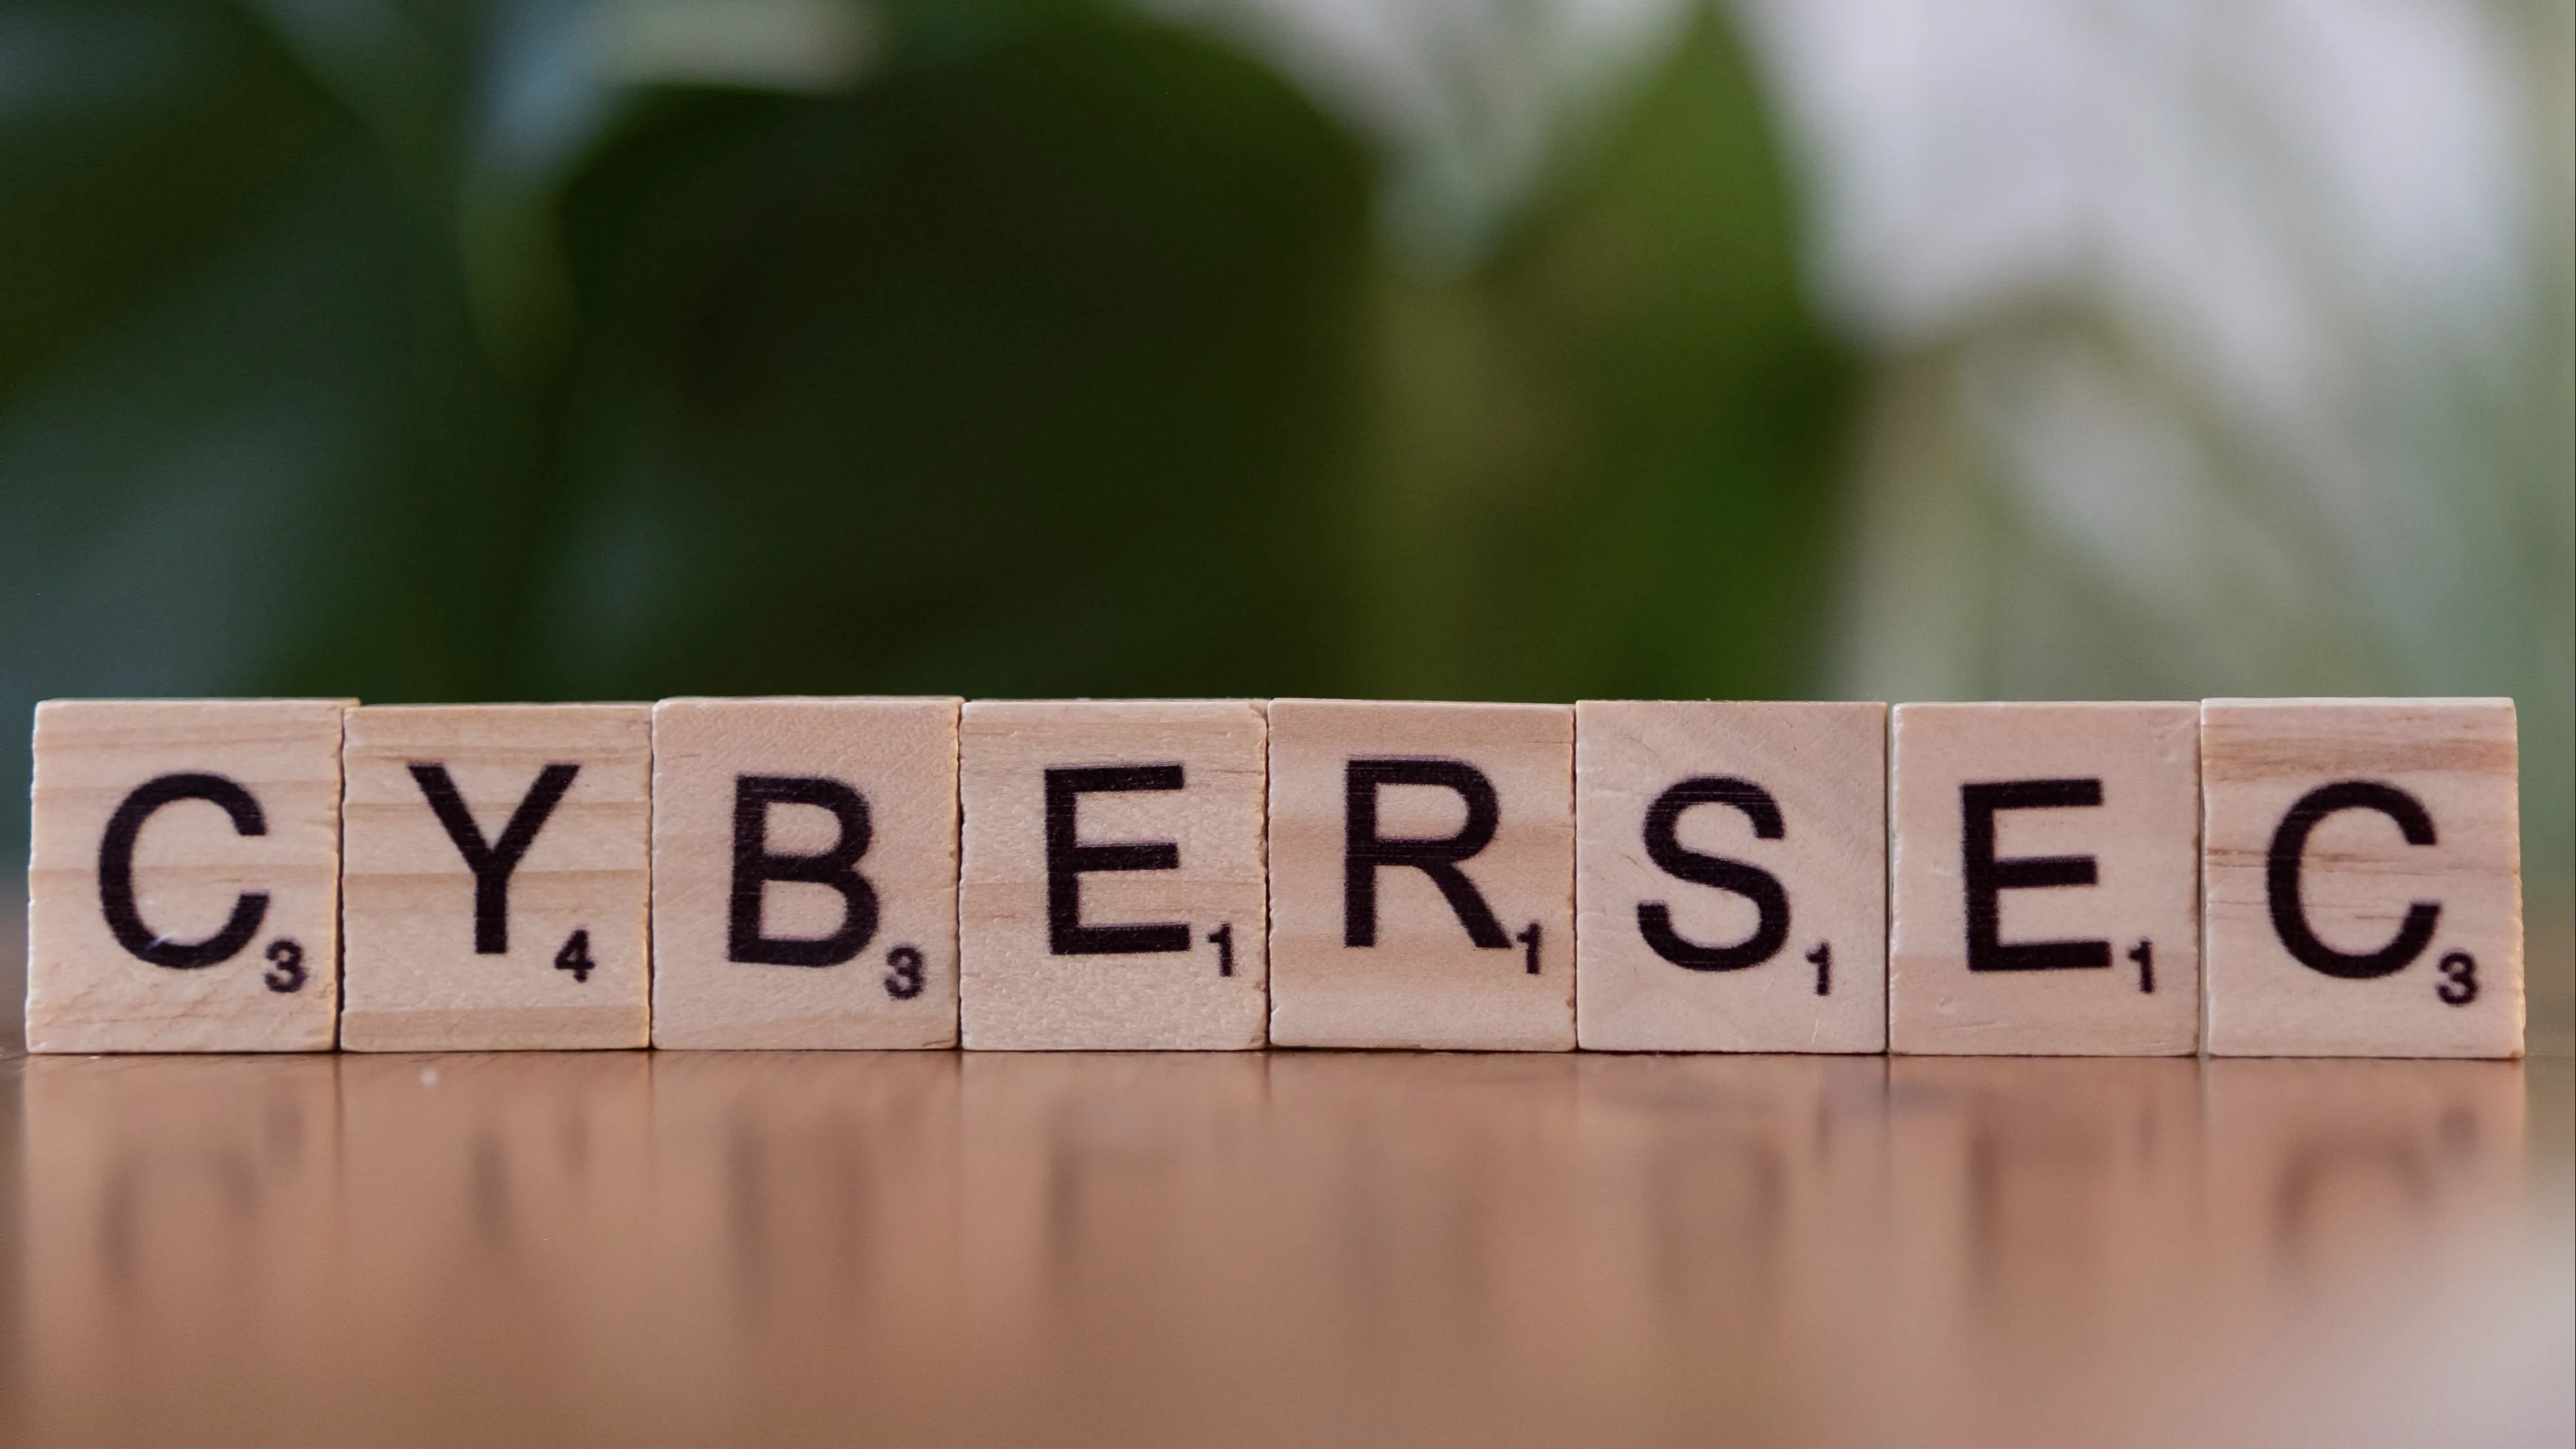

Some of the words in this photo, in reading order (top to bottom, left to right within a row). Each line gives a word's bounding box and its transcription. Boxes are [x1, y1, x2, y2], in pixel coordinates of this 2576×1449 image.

[264, 938, 309, 994] 3
[553, 928, 596, 984] 4
[883, 945, 927, 1001] 3
[1206, 922, 1236, 978] 1
[1515, 922, 1544, 976] 1
[1805, 941, 1833, 997] 1
[2126, 939, 2156, 995] 1
[2435, 951, 2480, 1008] 3
